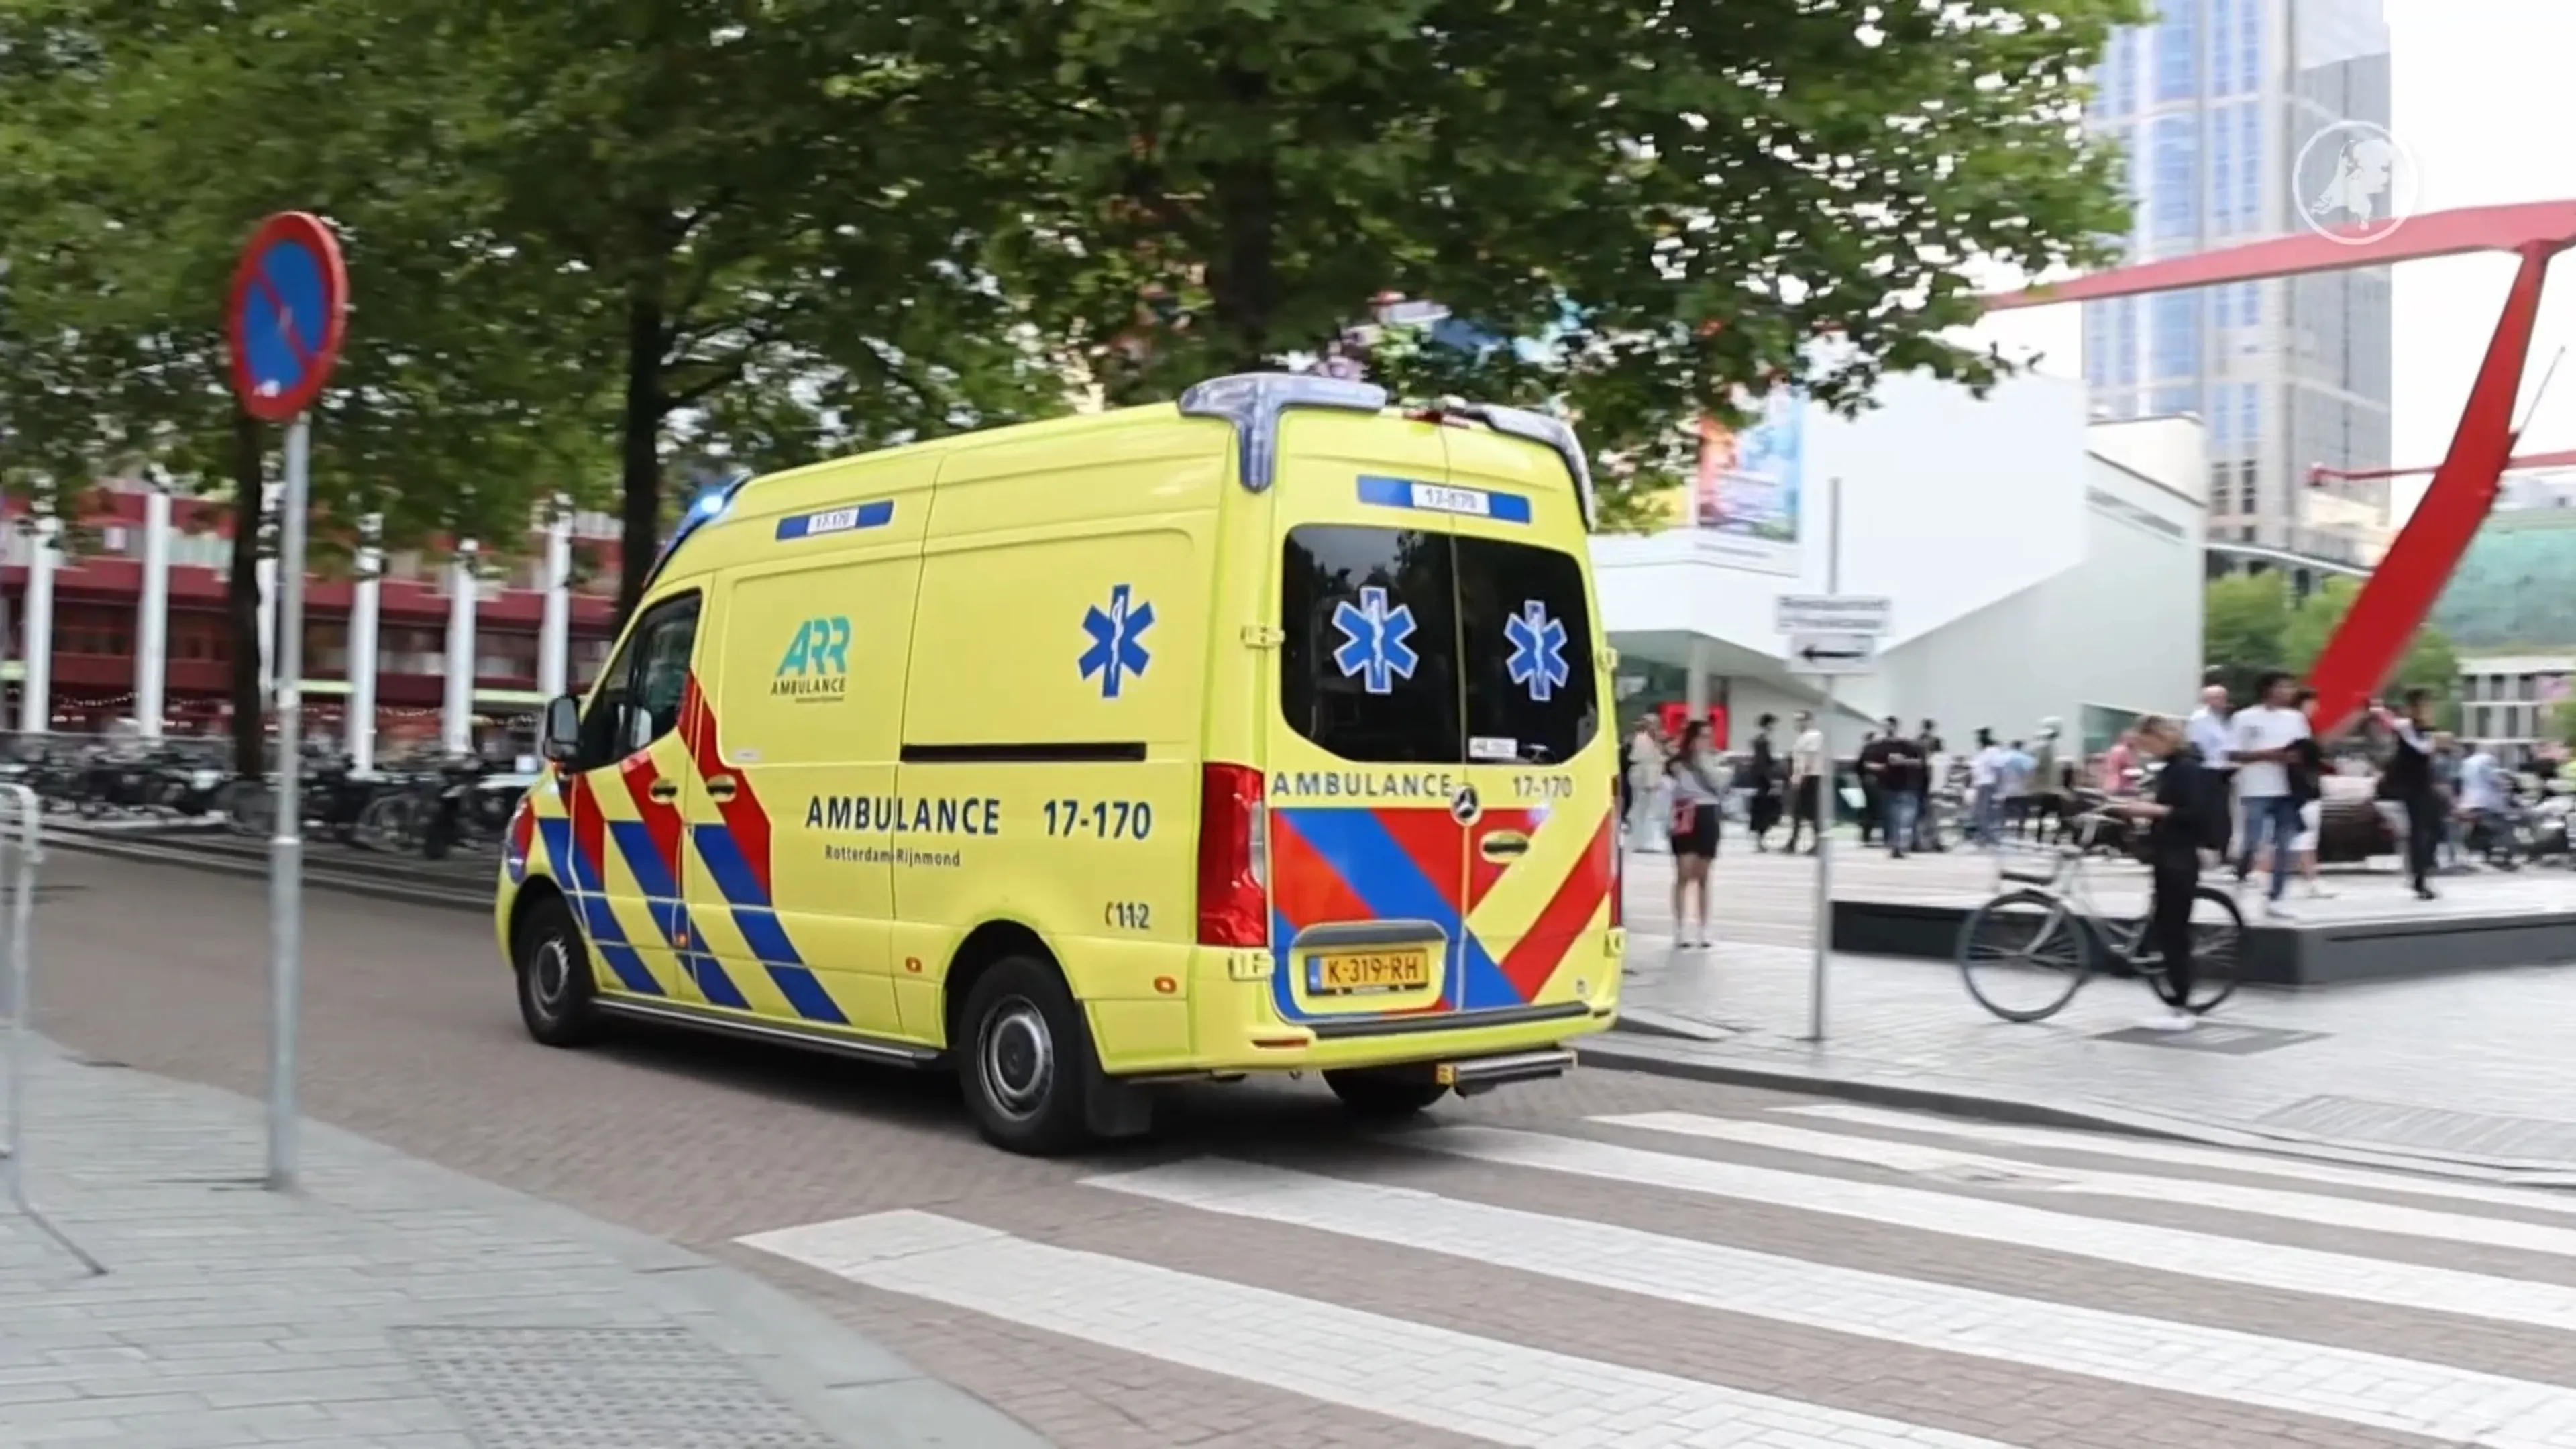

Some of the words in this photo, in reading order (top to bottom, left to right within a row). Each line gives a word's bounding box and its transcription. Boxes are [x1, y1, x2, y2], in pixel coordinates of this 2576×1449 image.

[776, 616, 851, 677] ARR
[770, 676, 846, 696] AMBULANCE
[1273, 771, 1453, 798] AMBULANCE
[1513, 775, 1573, 798] 17-170
[806, 795, 1000, 835] AMBULANCE
[1044, 800, 1152, 840] 17-170
[1328, 956, 1418, 983] K-319-RH
